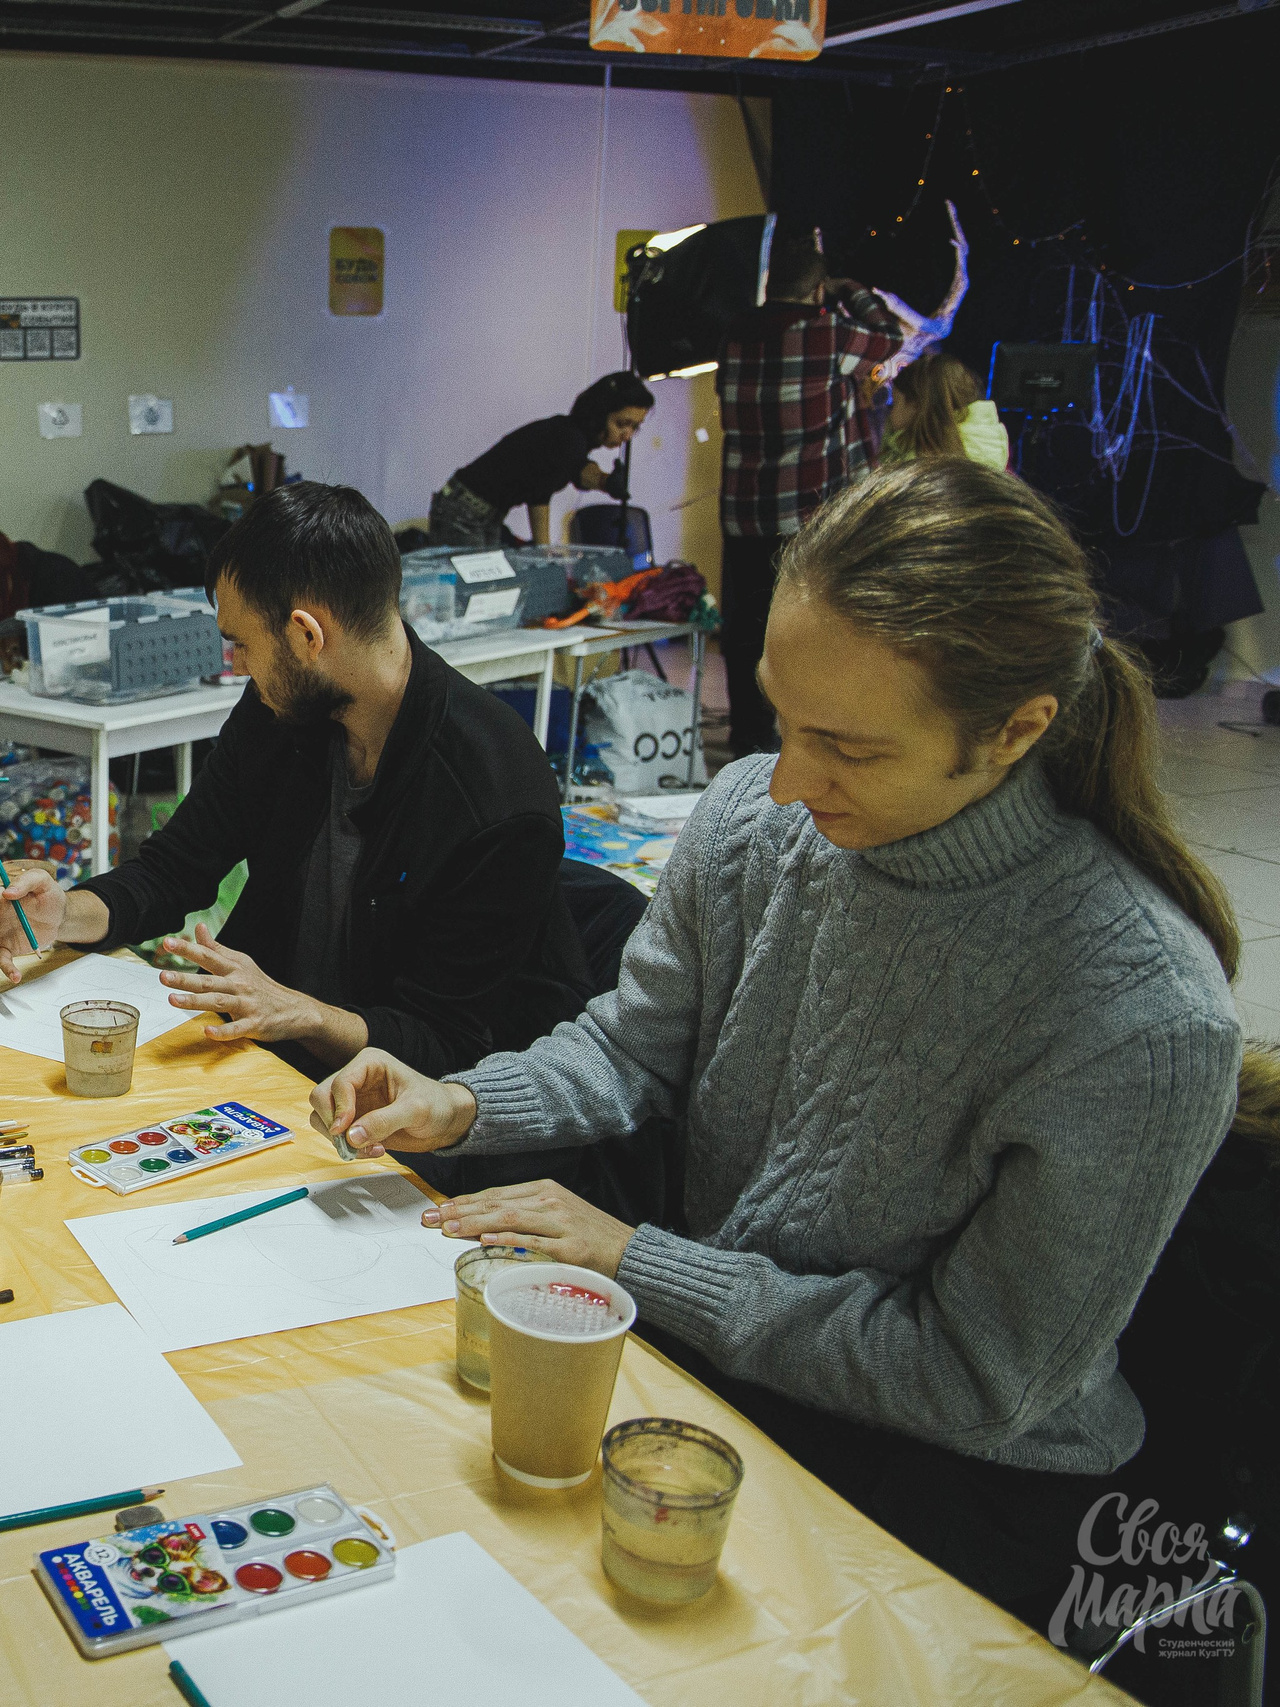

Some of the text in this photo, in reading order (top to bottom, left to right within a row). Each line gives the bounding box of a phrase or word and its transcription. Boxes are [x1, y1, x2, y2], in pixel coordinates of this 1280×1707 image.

[223, 1106, 276, 1134] АКВАРЕЛЬ
[95, 1548, 110, 1560] 12
[62, 1552, 118, 1627] АКВАРЕЛЬ
